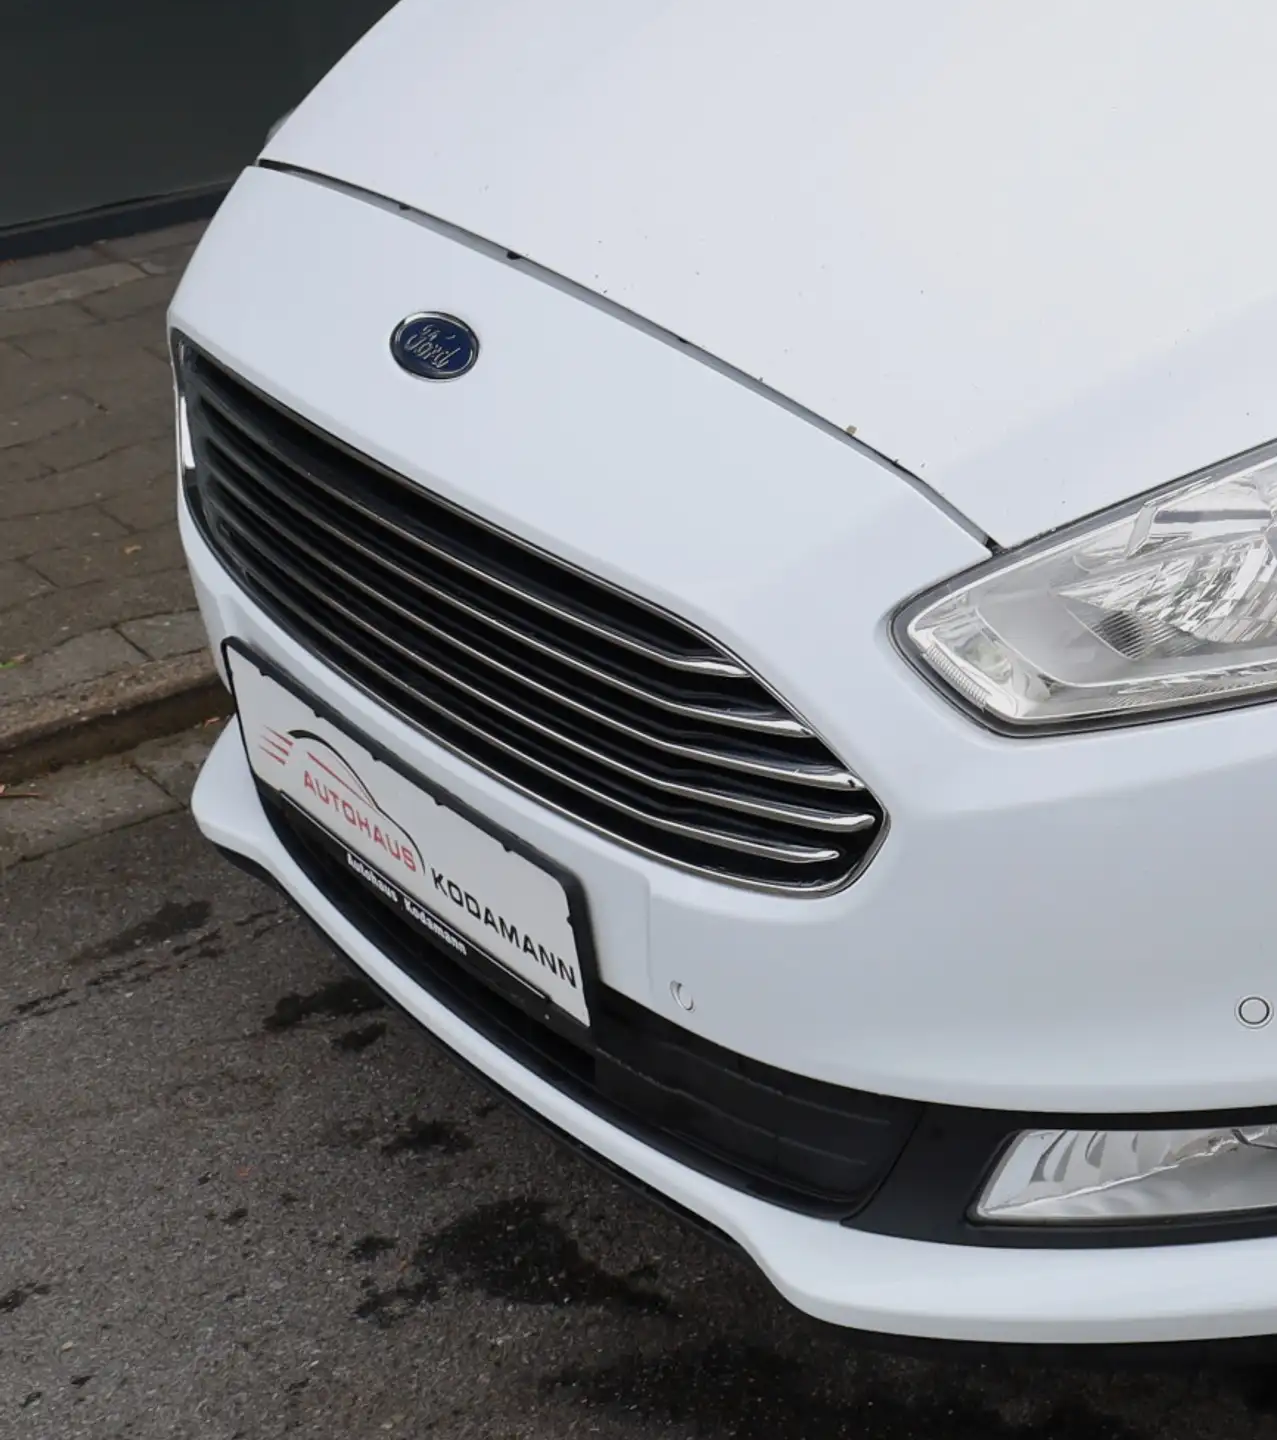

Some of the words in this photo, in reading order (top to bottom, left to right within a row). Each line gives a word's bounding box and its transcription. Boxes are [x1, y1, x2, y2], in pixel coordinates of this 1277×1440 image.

[403, 323, 461, 369] Ford
[302, 770, 417, 872] AUTOHAUS
[430, 866, 577, 990] KODAMANN
